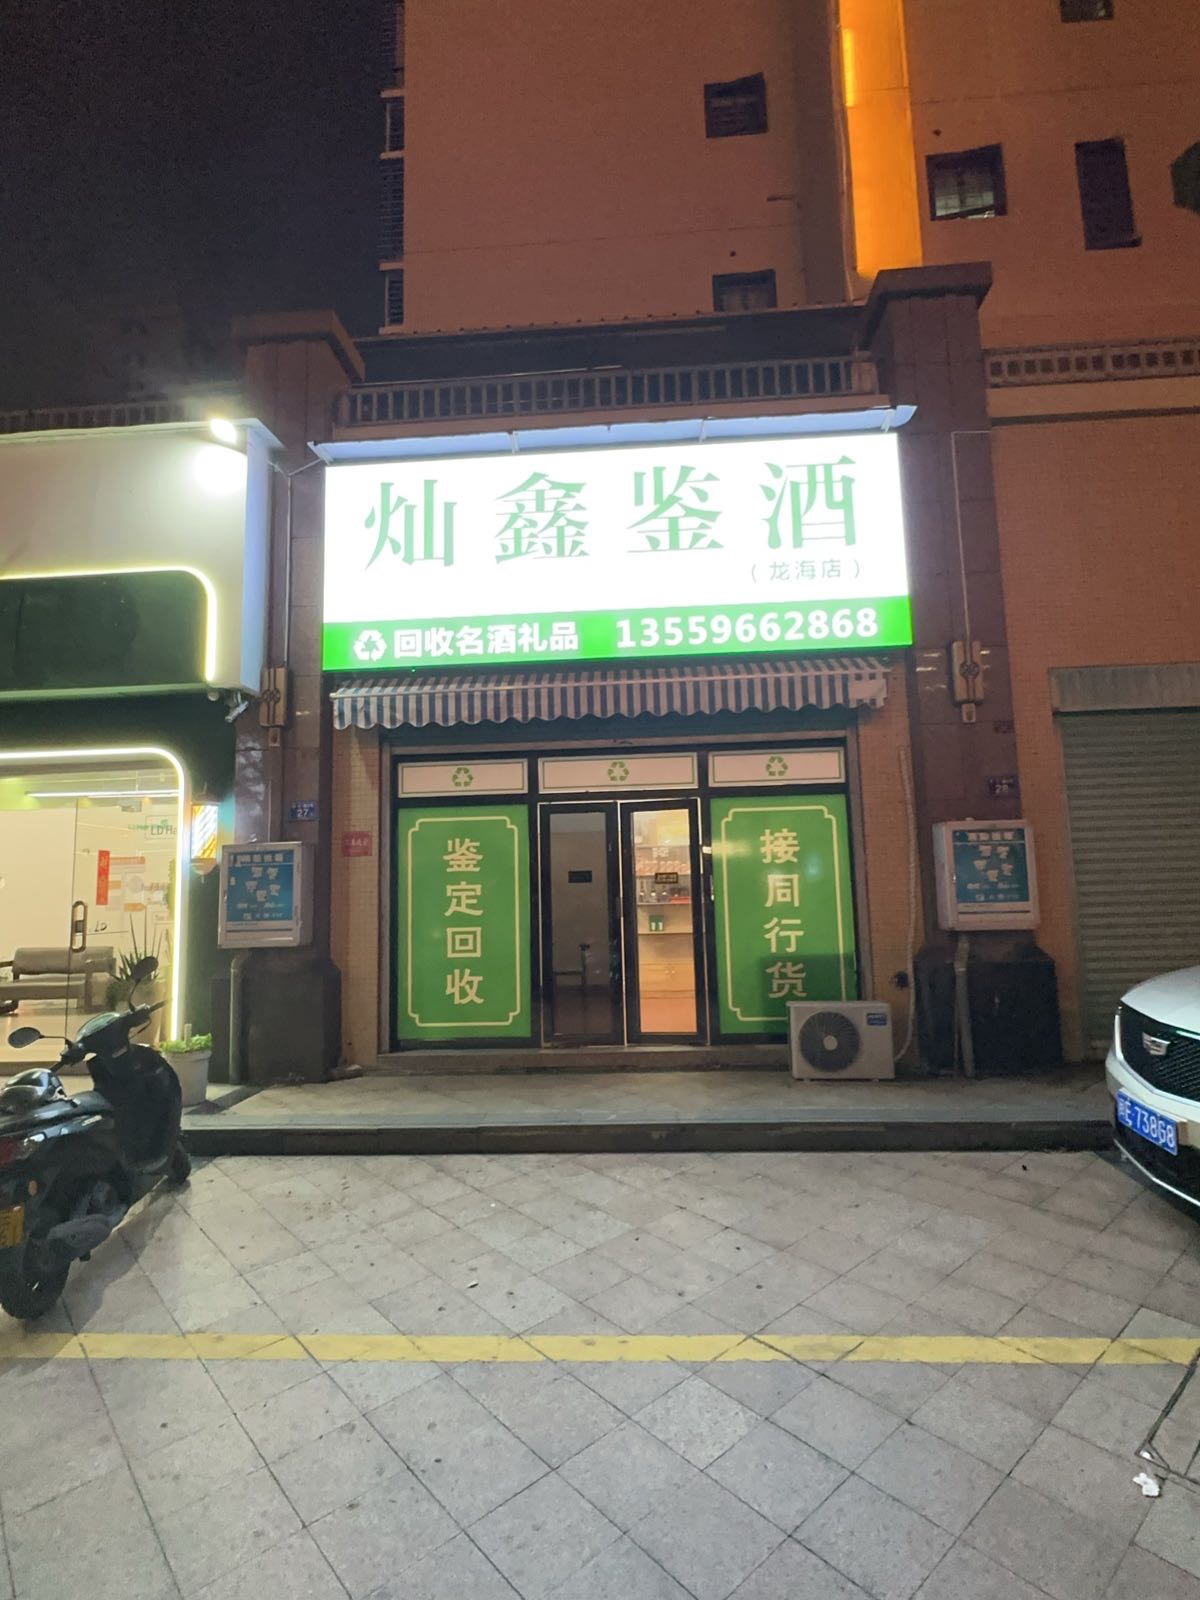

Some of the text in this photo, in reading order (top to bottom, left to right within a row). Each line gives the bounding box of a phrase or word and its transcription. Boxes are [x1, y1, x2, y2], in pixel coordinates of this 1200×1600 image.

[363, 454, 857, 572] 灿鑫鉴酒
[393, 620, 580, 660] 回收名酒礼品
[615, 607, 880, 650] 13559662868
[442, 838, 485, 1006] 鉴定回收
[760, 828, 808, 999] 接同行货
